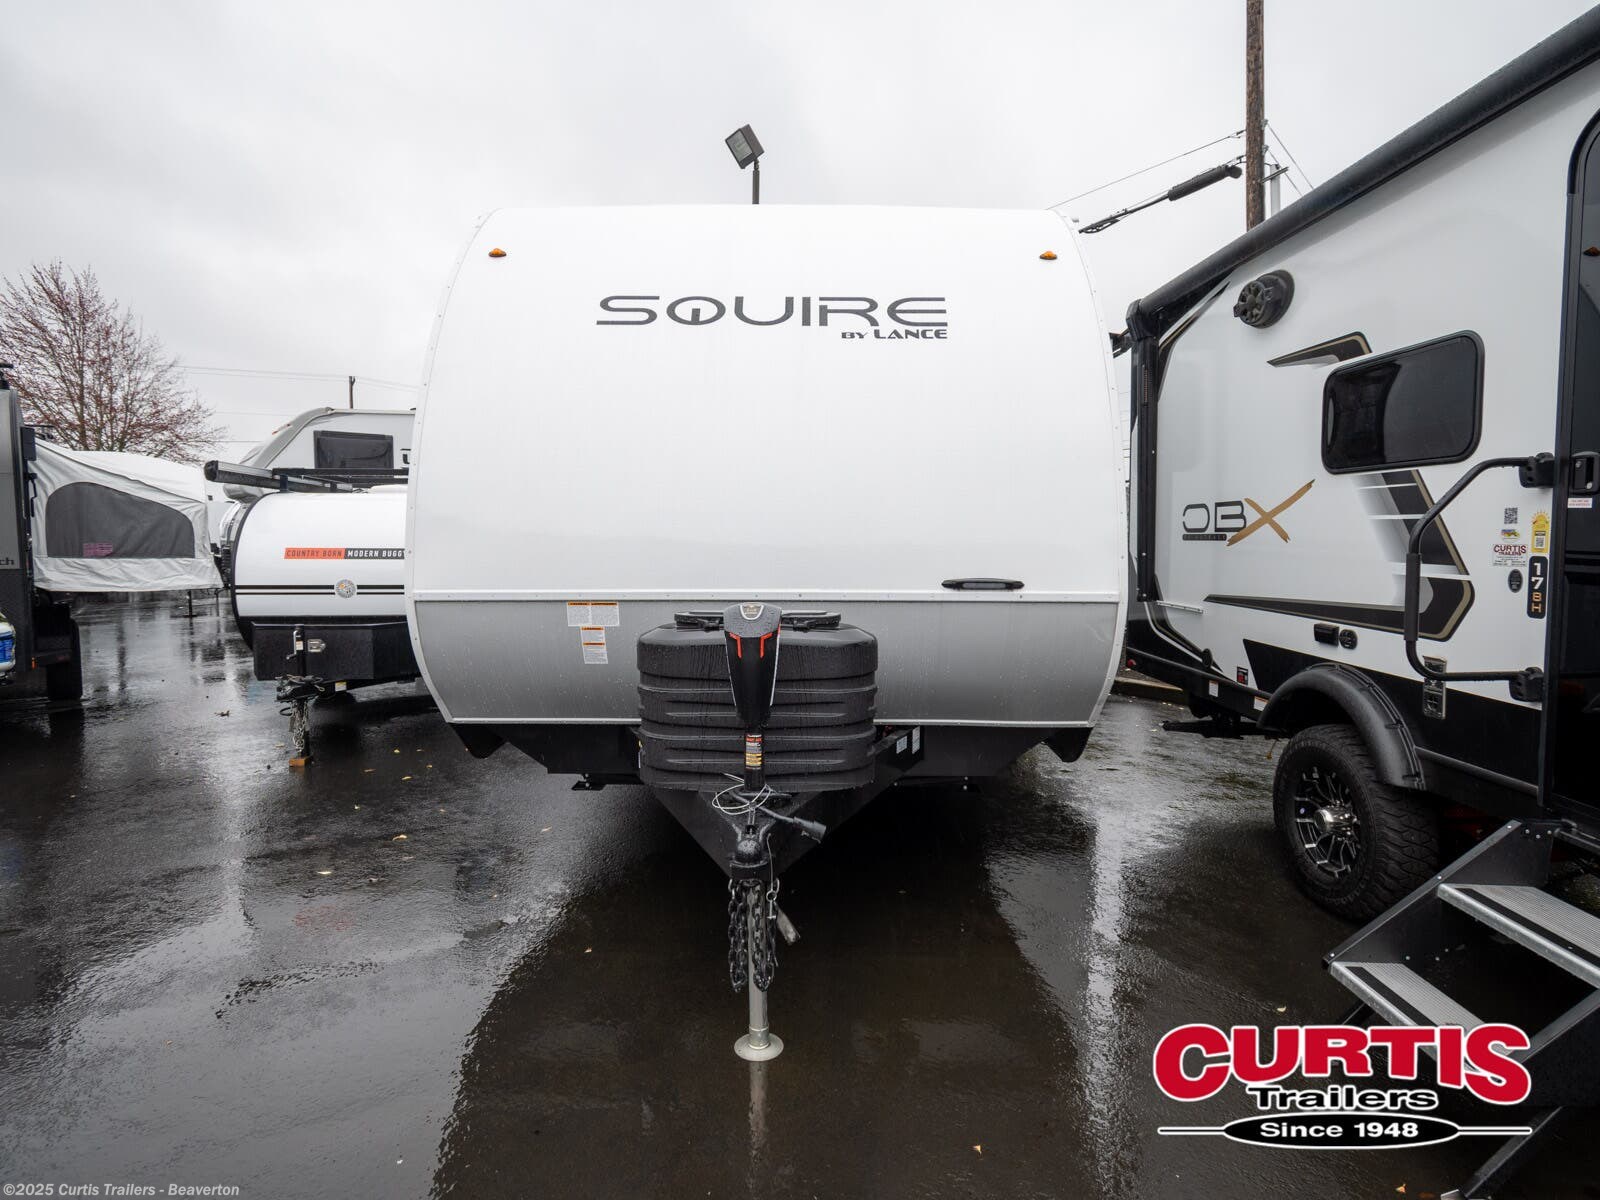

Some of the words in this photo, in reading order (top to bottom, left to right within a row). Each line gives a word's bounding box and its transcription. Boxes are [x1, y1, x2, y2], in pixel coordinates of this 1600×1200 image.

[596, 295, 948, 327] SQUIRE
[841, 331, 868, 339] BY
[873, 329, 948, 339] LANCE
[1182, 478, 1316, 546] OBX
[286, 549, 319, 557] COUNTRY
[322, 549, 342, 557] BORN
[347, 549, 379, 558] MODERN
[1493, 544, 1526, 554] CURTIS
